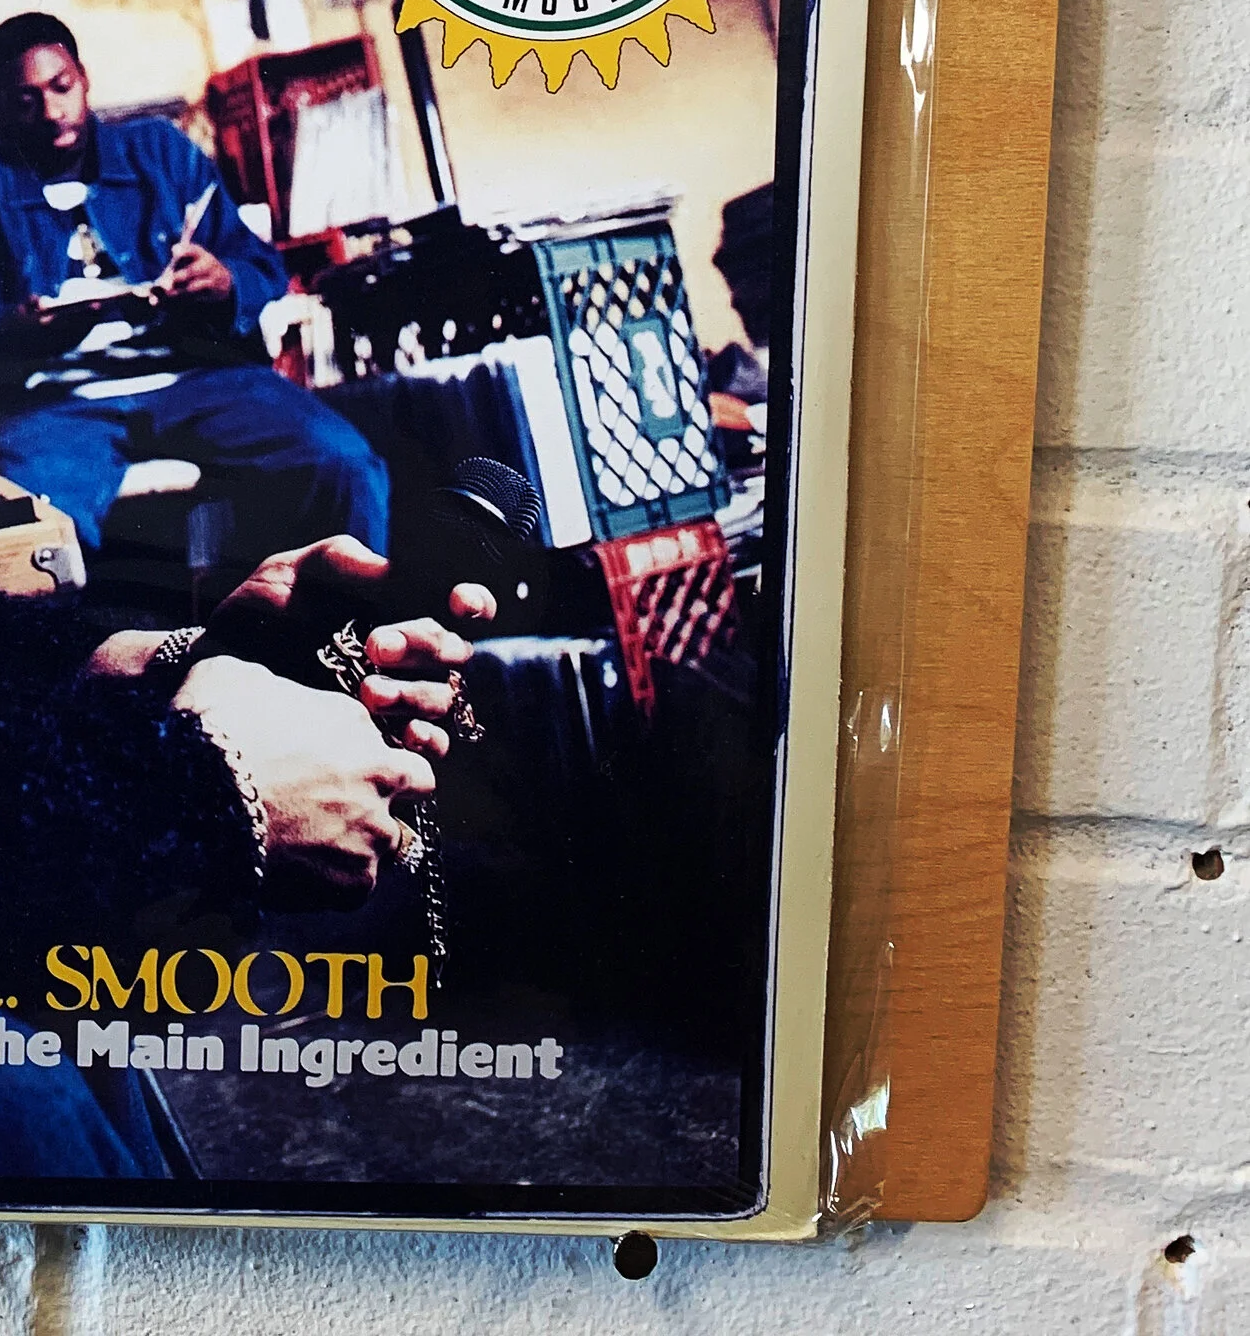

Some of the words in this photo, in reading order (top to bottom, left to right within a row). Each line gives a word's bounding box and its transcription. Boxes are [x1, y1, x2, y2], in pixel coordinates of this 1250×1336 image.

[45, 944, 430, 1021] SMOOTH
[76, 1019, 224, 1072] Main
[240, 1024, 564, 1089] Ingredient
